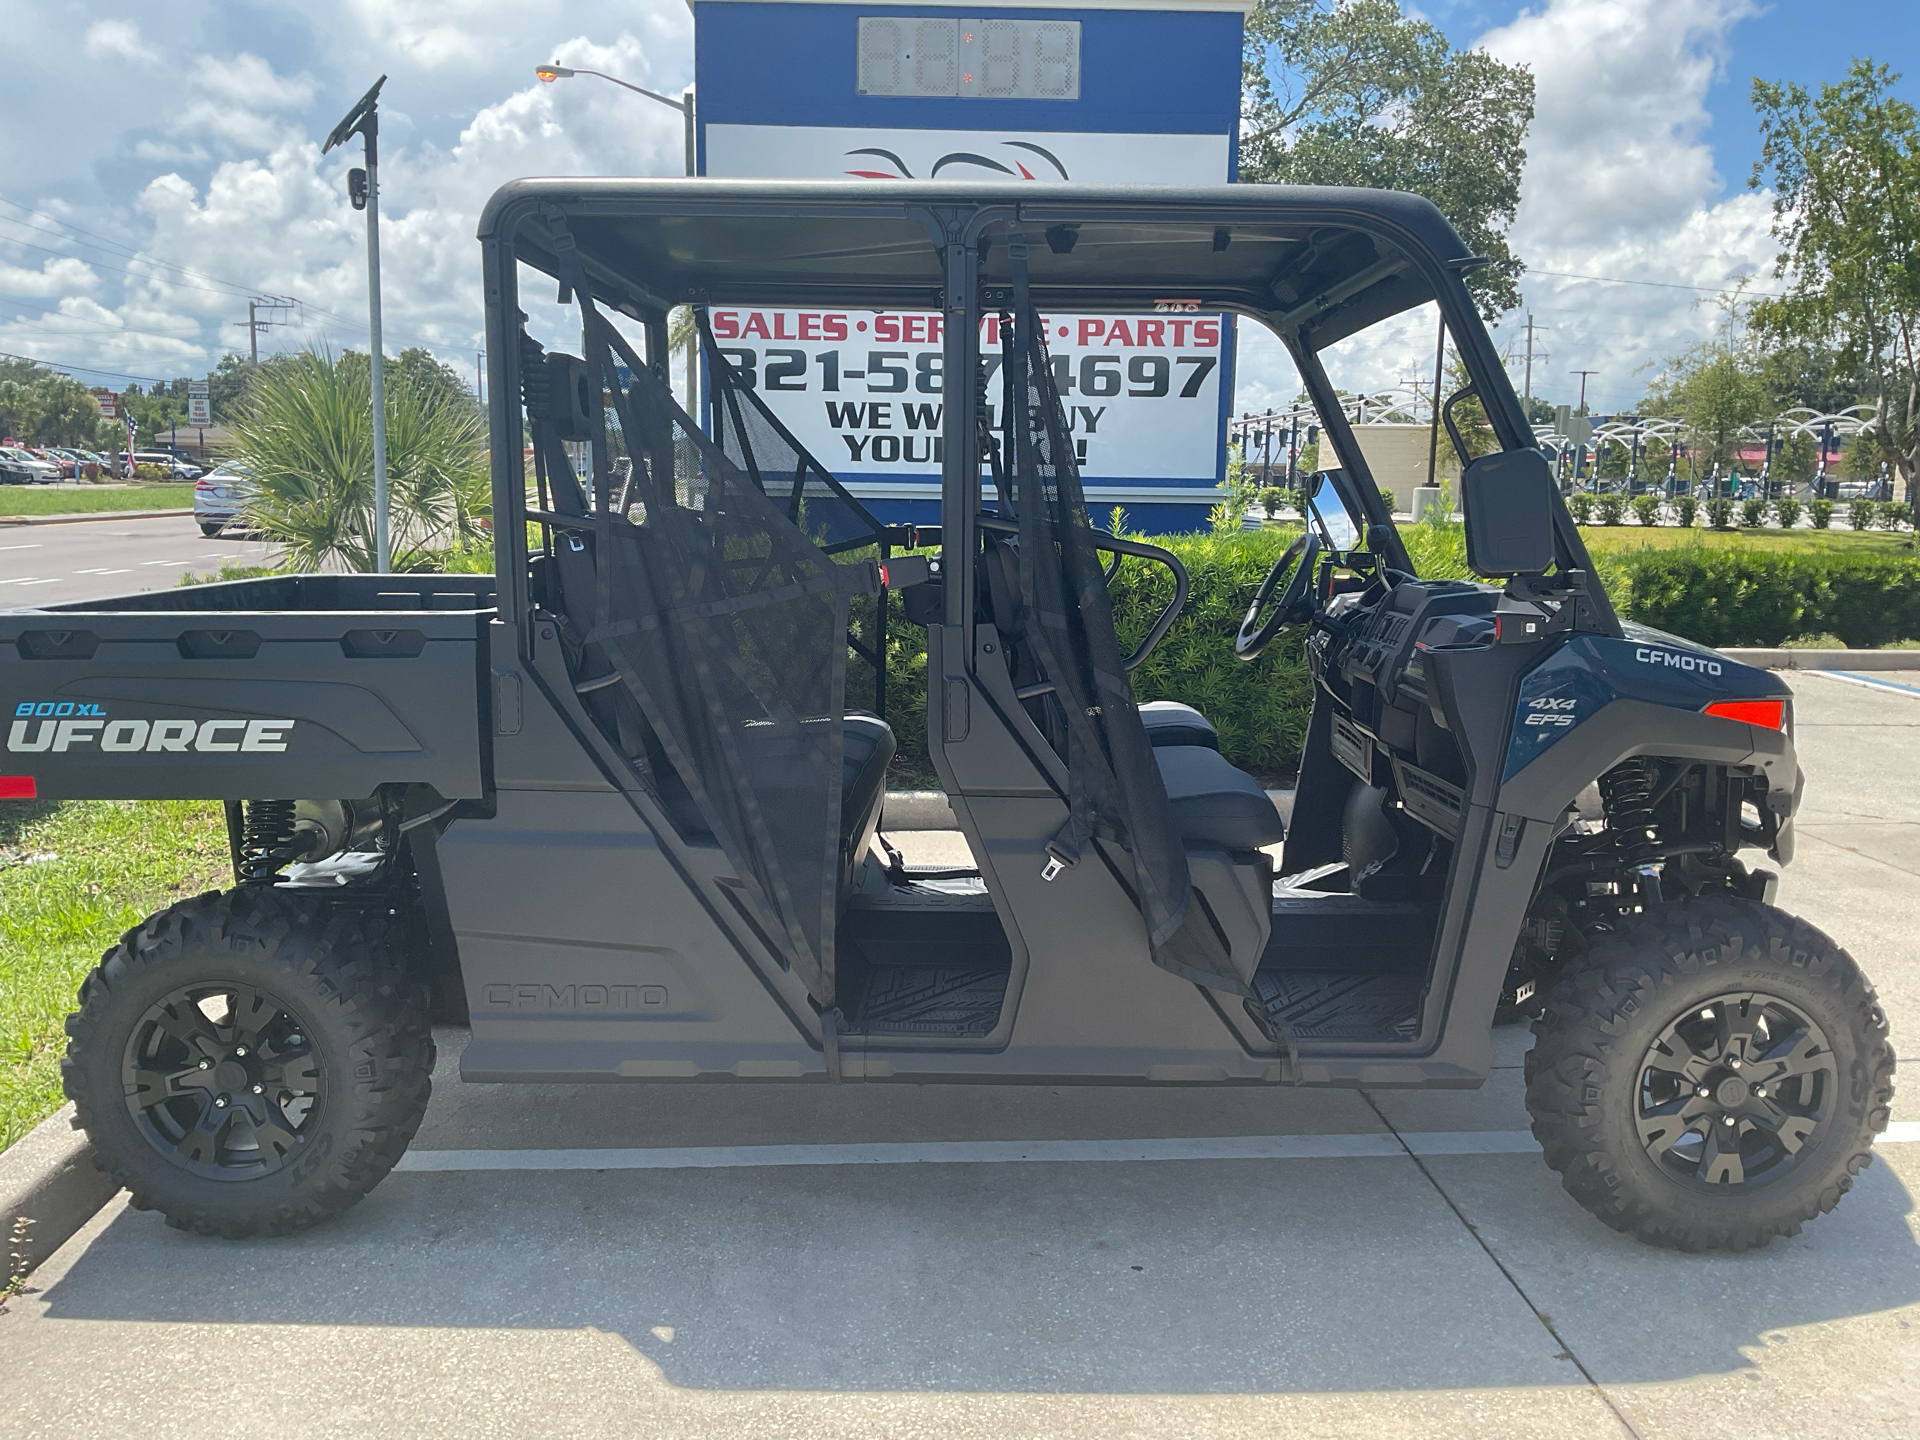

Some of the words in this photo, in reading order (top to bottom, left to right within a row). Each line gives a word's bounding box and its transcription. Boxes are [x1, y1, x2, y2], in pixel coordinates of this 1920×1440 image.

[713, 311, 848, 341] SALES
[875, 315, 1049, 345] SERI
[1077, 319, 1219, 348] PARTS
[717, 348, 1217, 398] 321-5874697
[825, 401, 892, 429] WE
[902, 403, 1005, 431] WL
[842, 435, 943, 463] YOU
[1636, 648, 1722, 676] CFMOTO
[1528, 697, 1577, 710] 4X4
[1524, 713, 1575, 726] EPS
[6, 719, 296, 752] UFORCE
[482, 984, 668, 1009] CFMOTO
